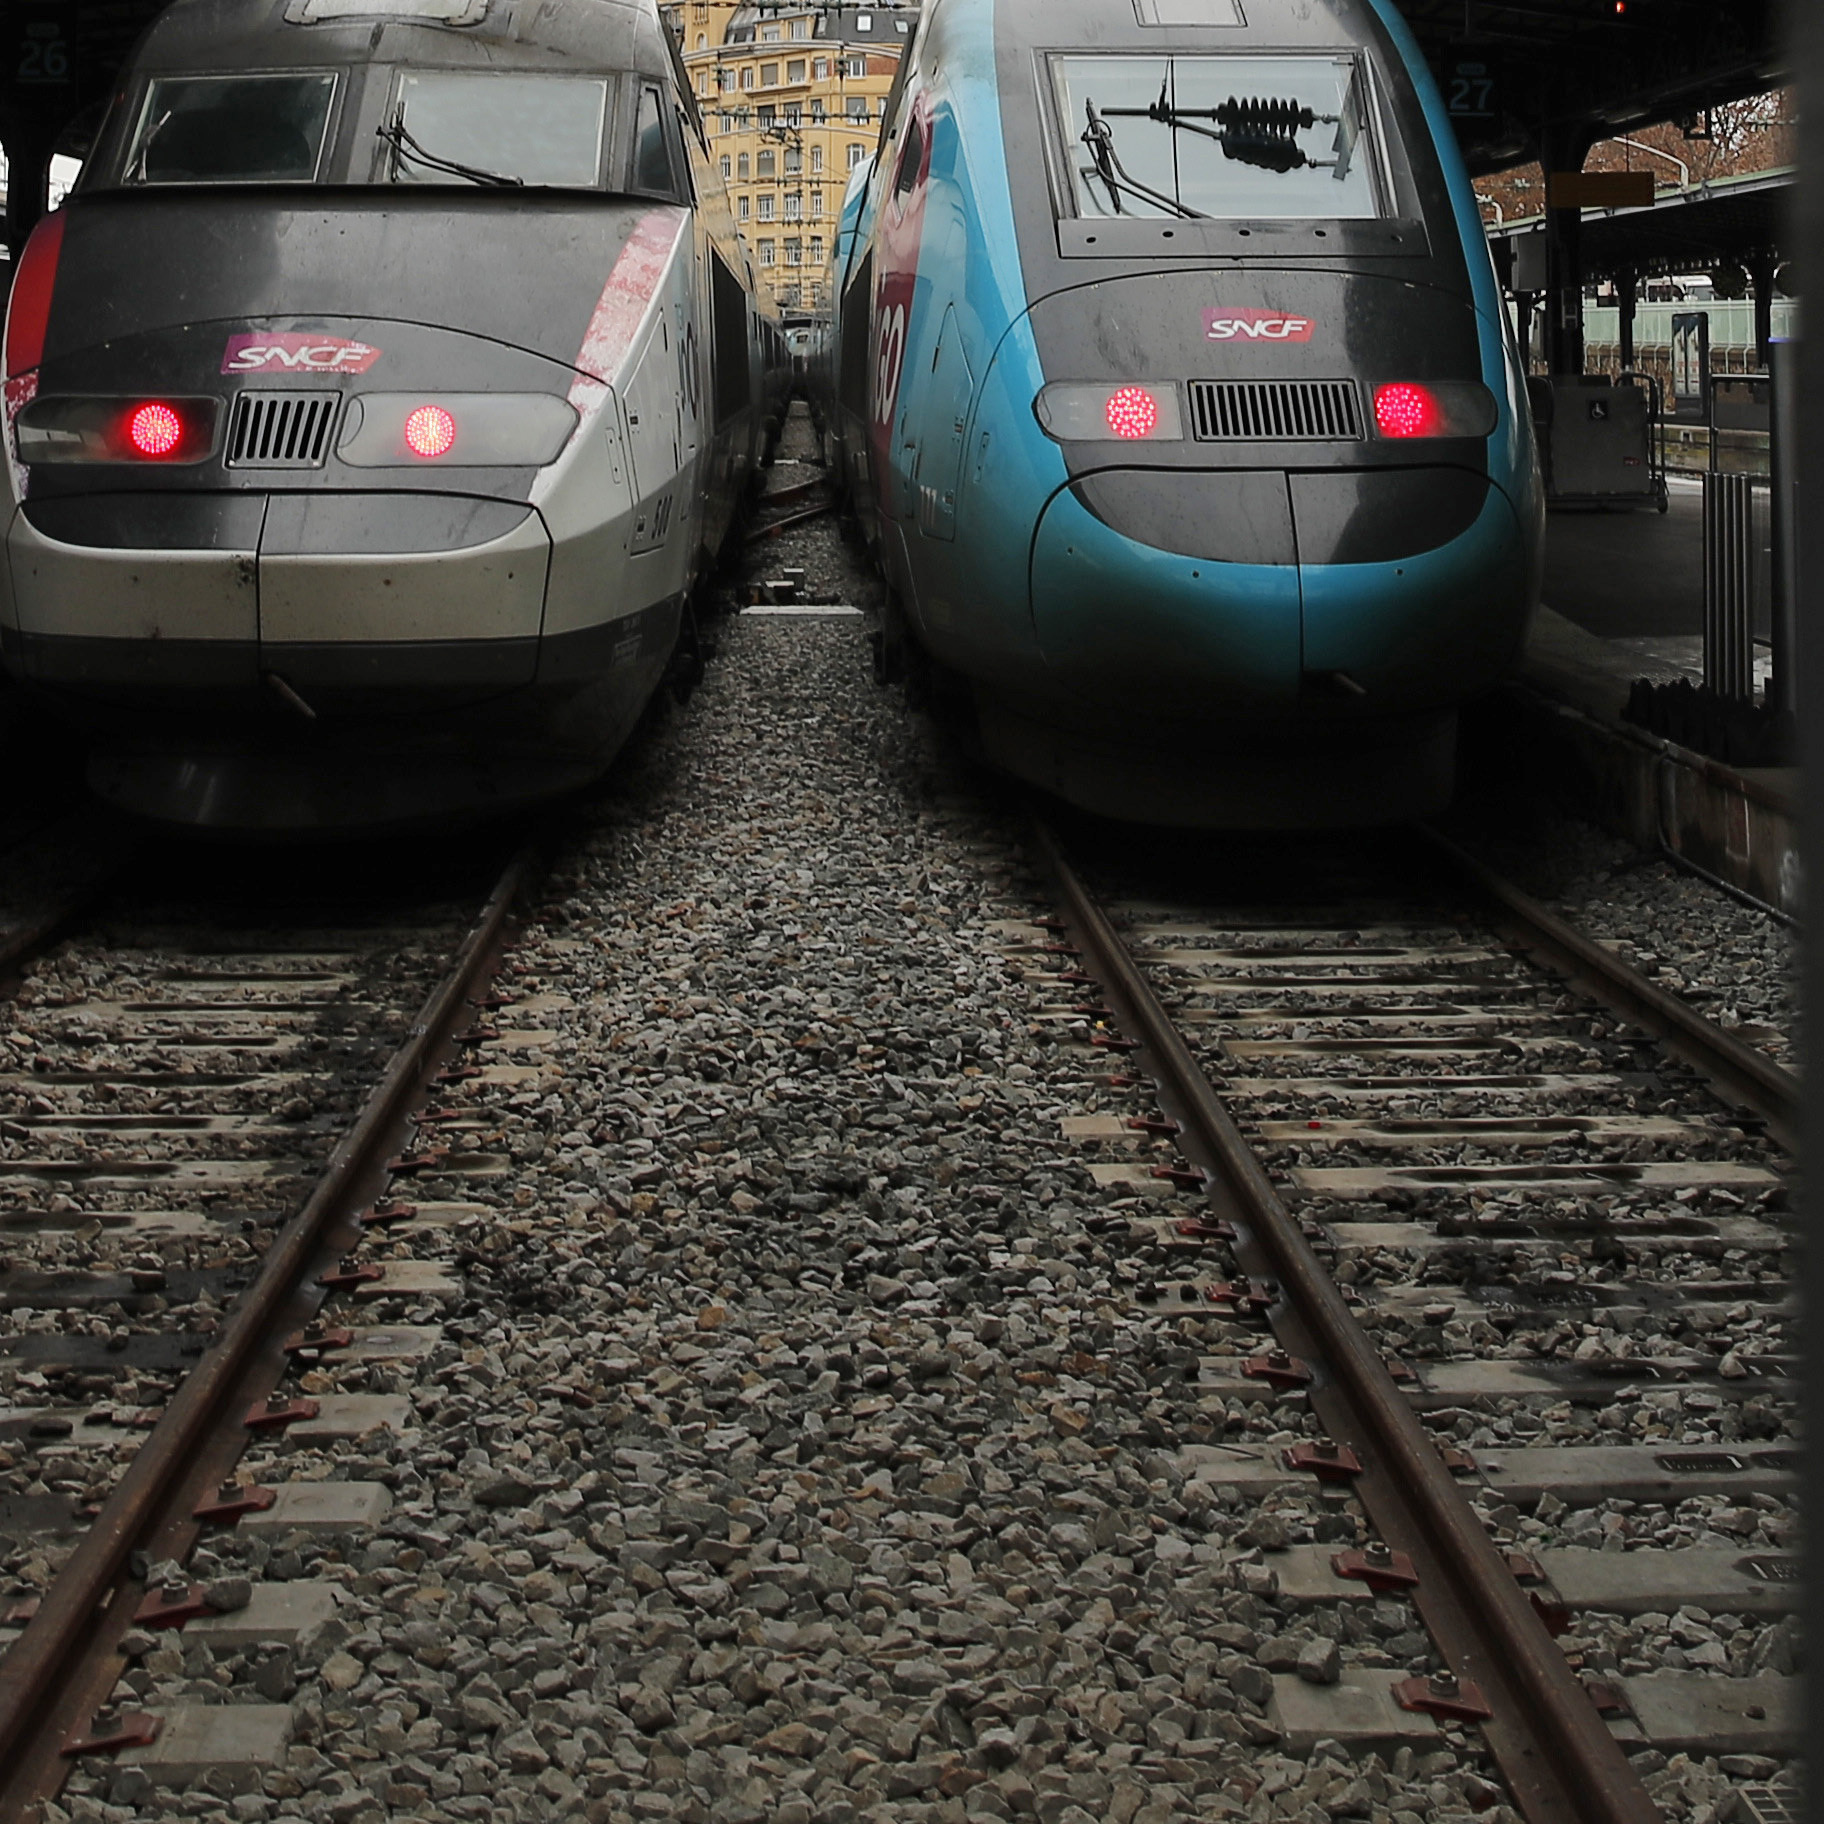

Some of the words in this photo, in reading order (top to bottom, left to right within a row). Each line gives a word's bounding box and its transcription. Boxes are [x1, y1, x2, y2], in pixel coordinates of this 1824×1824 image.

[18, 41, 68, 77] 26
[1449, 79, 1495, 110] 27
[1207, 319, 1308, 338] SNCF
[228, 345, 372, 369] SNCF
